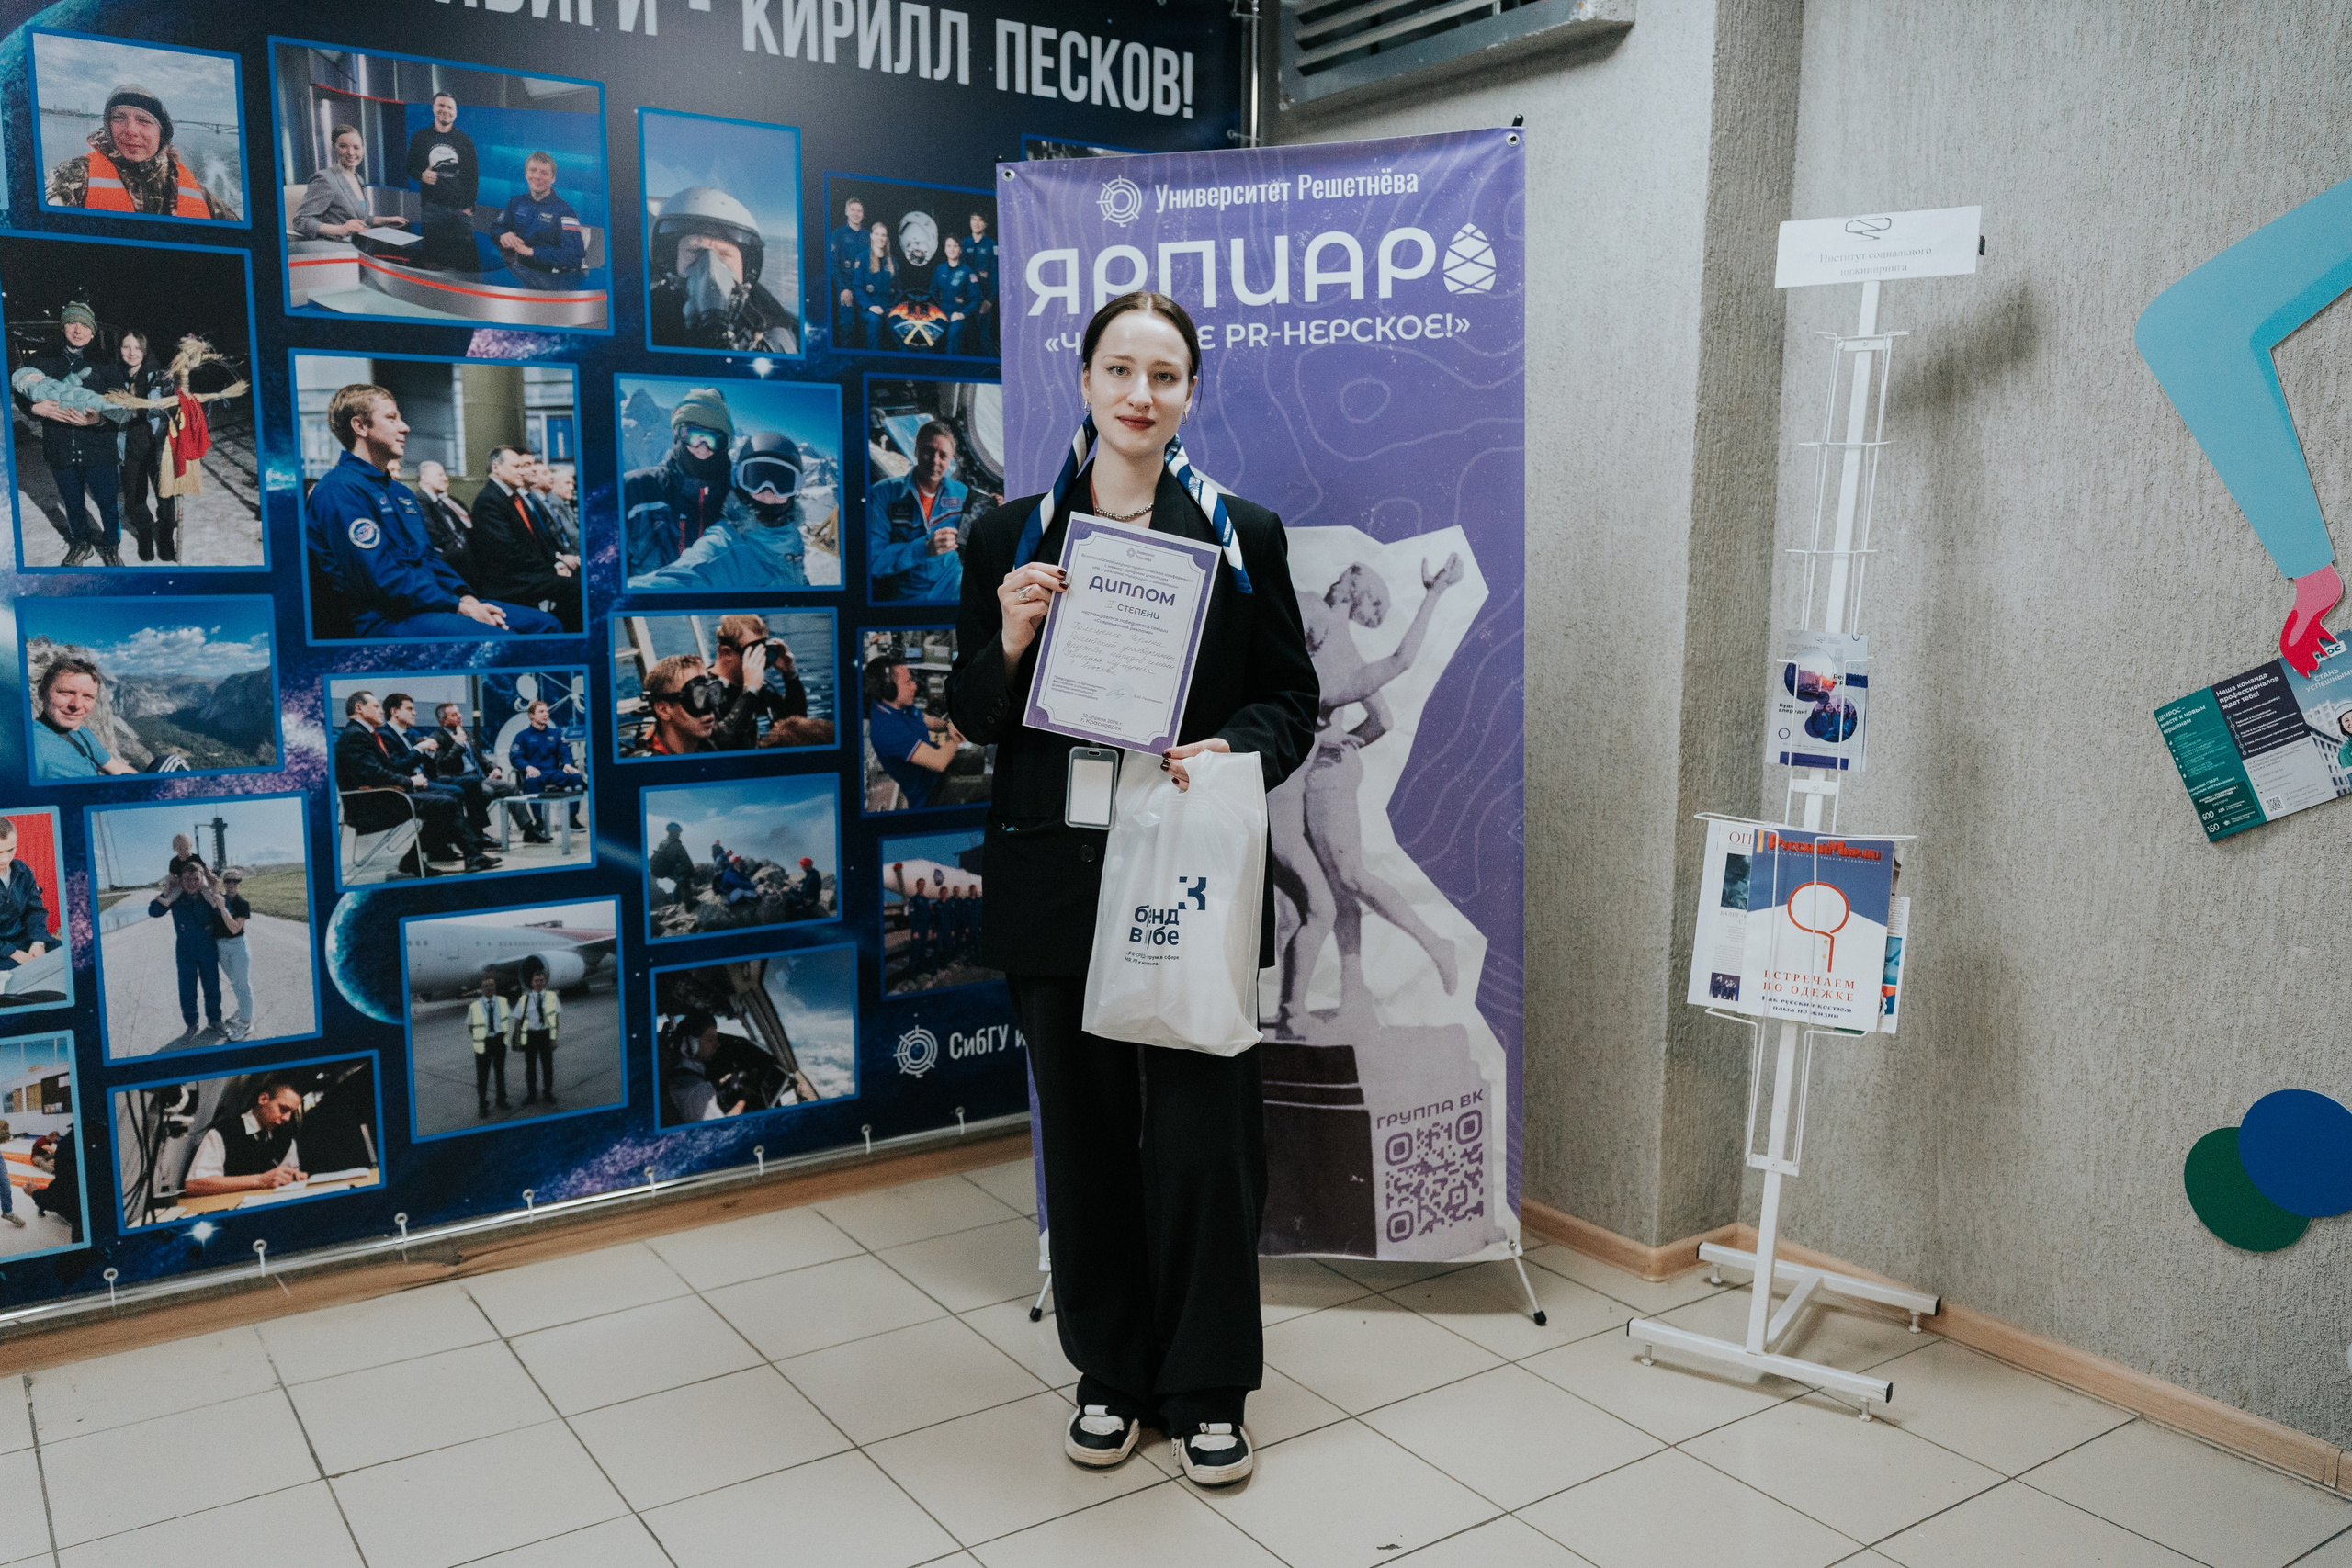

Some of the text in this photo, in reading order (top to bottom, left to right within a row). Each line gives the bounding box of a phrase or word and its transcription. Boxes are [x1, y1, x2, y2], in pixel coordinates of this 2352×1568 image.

[742, 0, 969, 85] КИРИЛЛ
[996, 18, 1193, 119] ПЕСКОВ!
[1155, 169, 1419, 213] Университет Решетнёва
[1820, 248, 1932, 263] Институт социального
[1024, 227, 1437, 316] ЯРПИАР
[1840, 264, 1907, 276] инжиниринга
[1089, 575, 1176, 606] ДИПЛОМ
[1117, 604, 1160, 620] СТЕПЕНИ
[2216, 672, 2267, 696] Наша команда
[2313, 668, 2339, 682] СТАНЬ
[2219, 676, 2279, 703] профессионалов
[2222, 691, 2260, 710] ждет тебя!
[1085, 718, 1122, 731] Красноярск
[2160, 716, 2178, 728] вместе
[2184, 705, 2206, 717] новым
[2202, 810, 2215, 821] 600
[2207, 823, 2220, 833] 150
[1764, 969, 1855, 990] ВСТРЕЧАЕМ
[1763, 982, 1854, 1002] ПО ОДЕЖКЕ
[949, 1023, 1009, 1060] СибГУ
[1377, 1089, 1484, 1130] ГРУППА ВК
